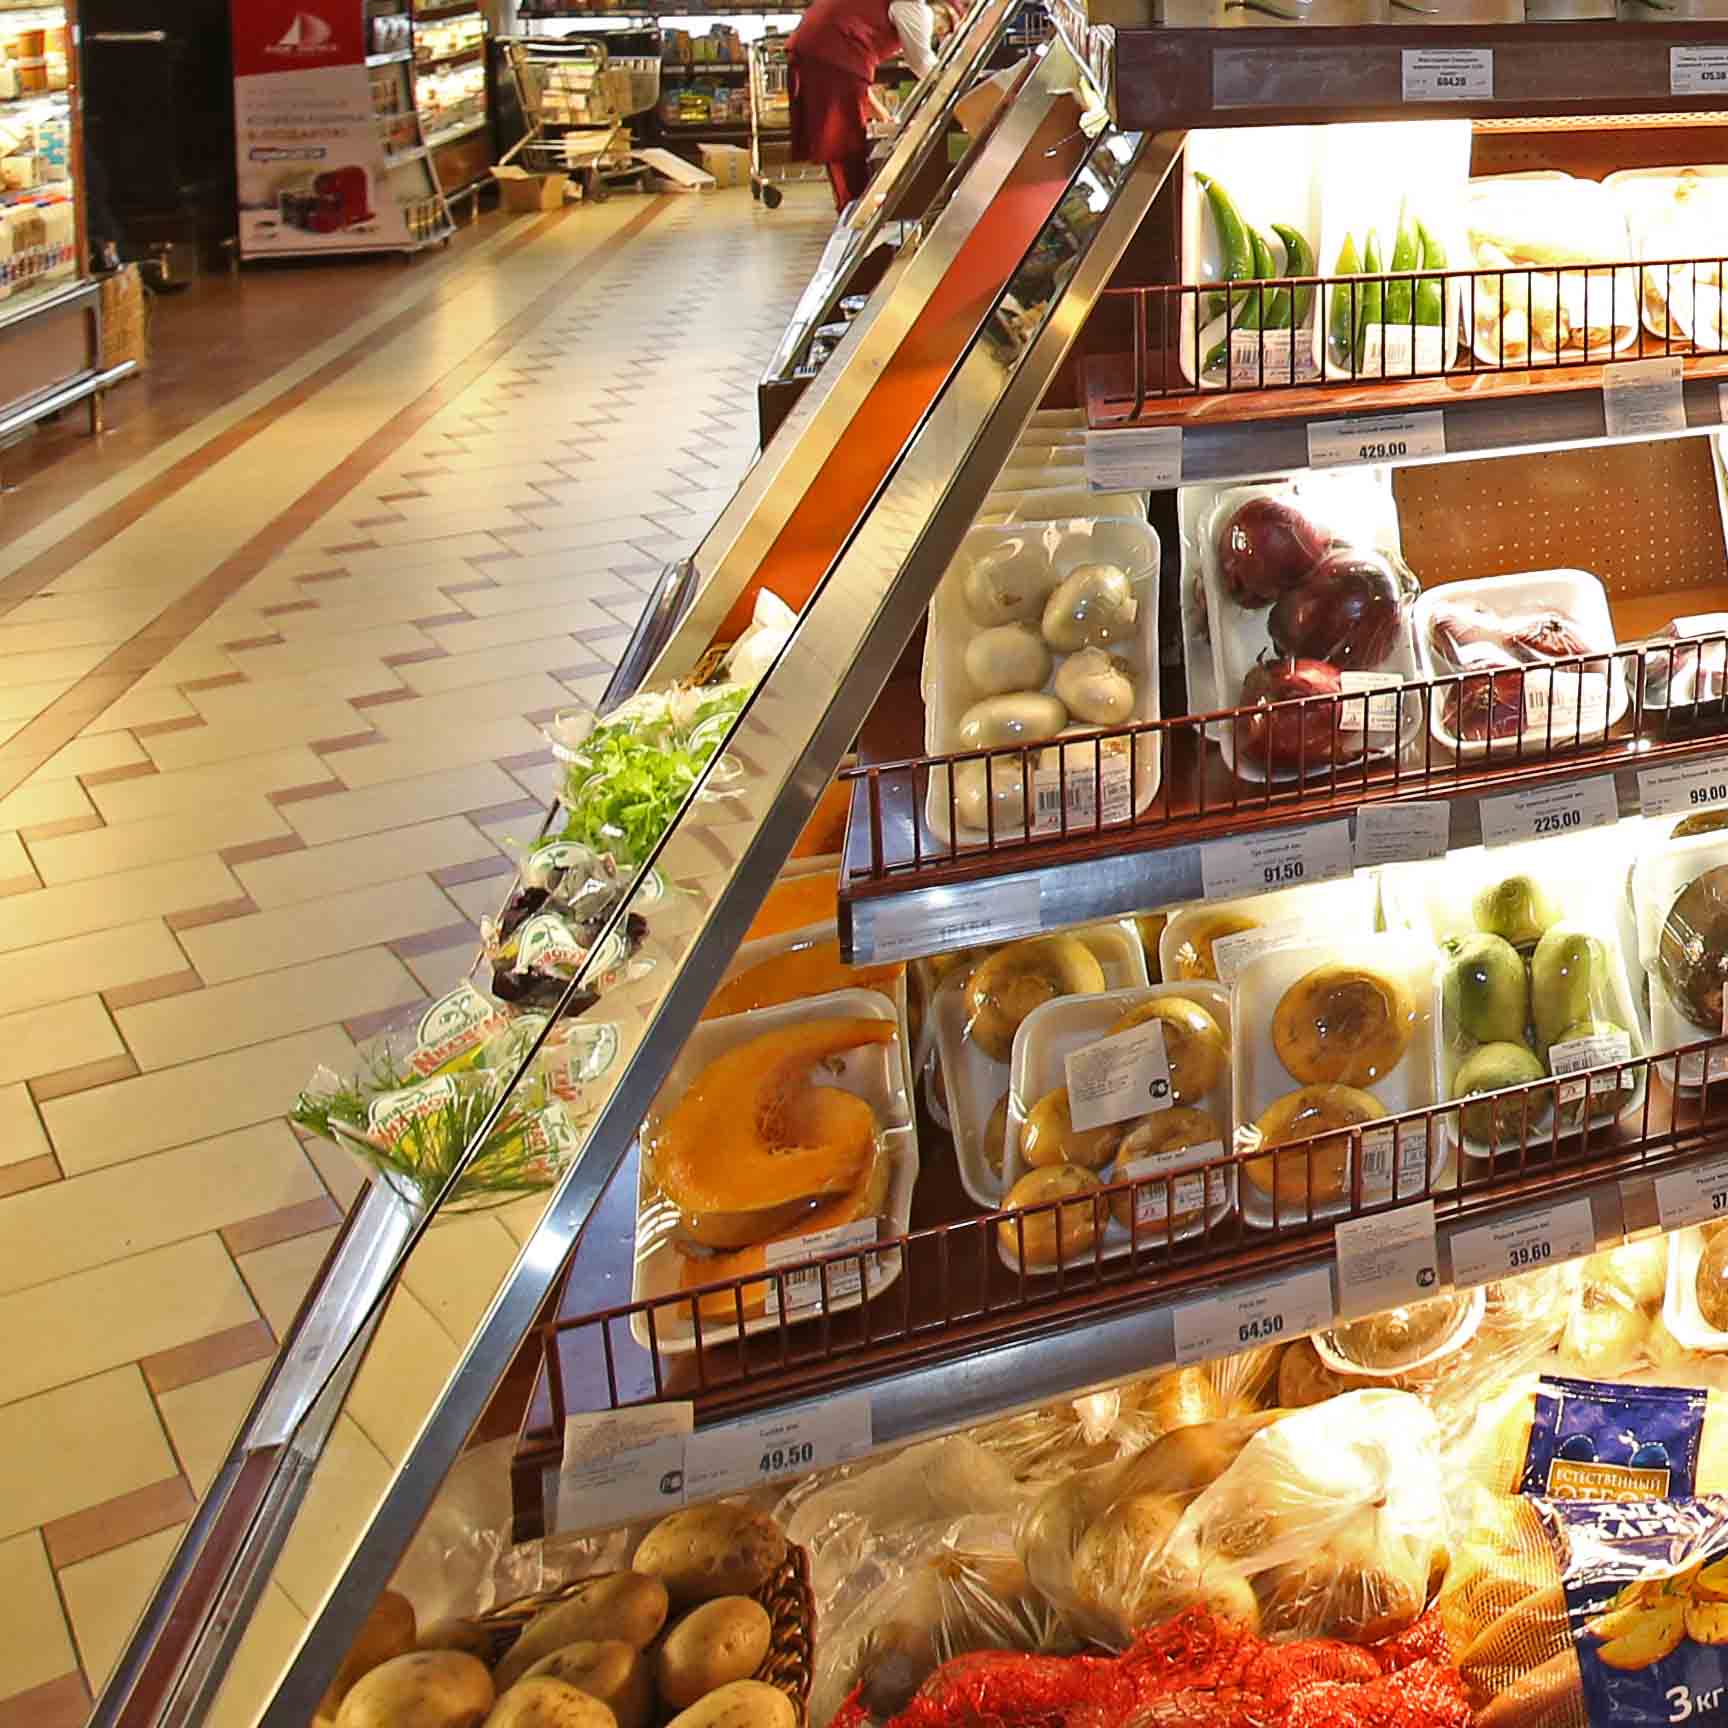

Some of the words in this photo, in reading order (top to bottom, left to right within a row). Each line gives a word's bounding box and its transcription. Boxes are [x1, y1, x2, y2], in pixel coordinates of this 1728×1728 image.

[1555, 1471, 1661, 1491] ЕСТЕСТВЕННЫЙ
[1665, 1684, 1693, 1724] 3
[1695, 1687, 1726, 1713] кг
